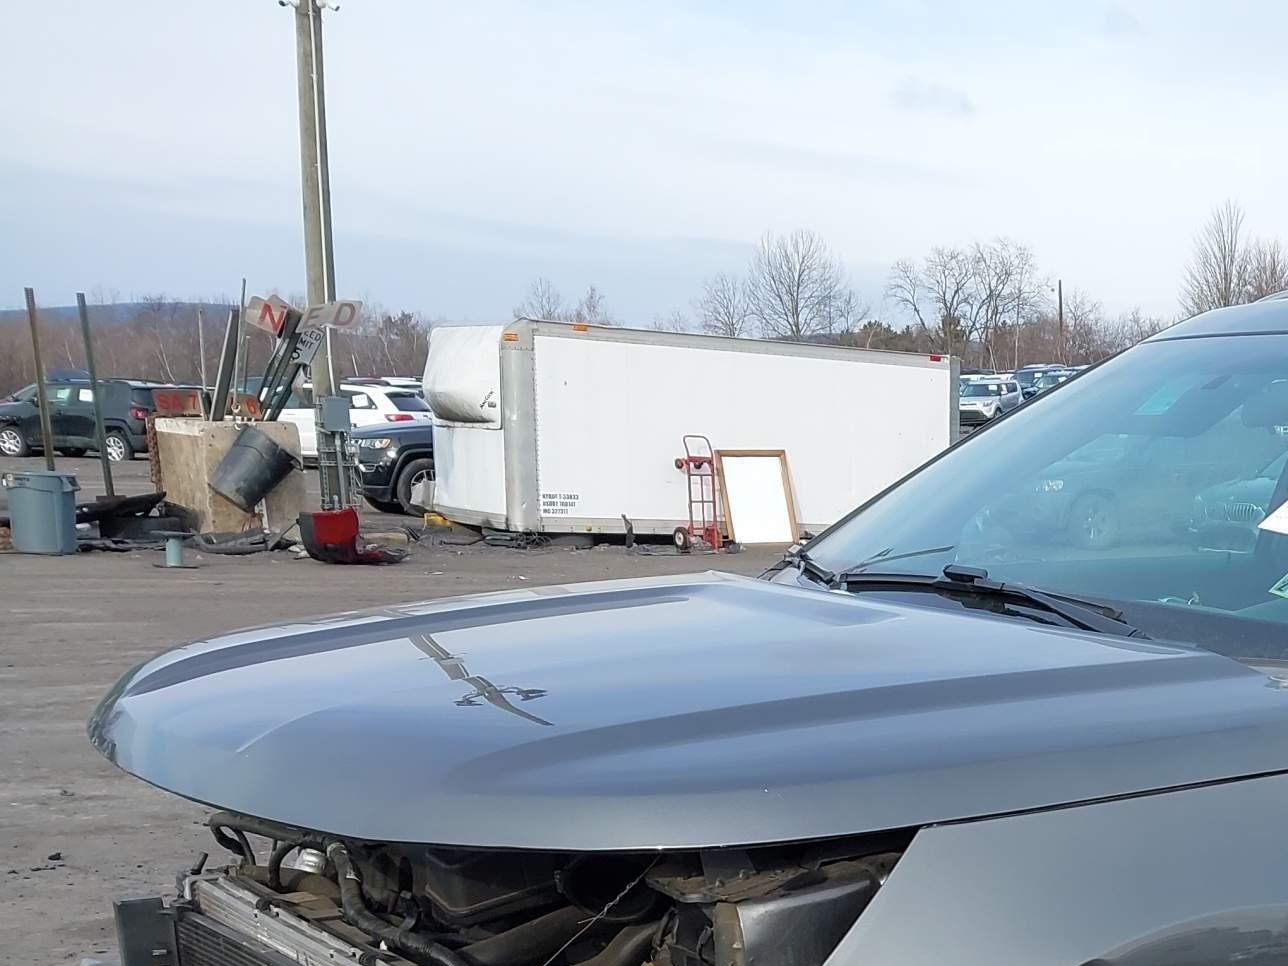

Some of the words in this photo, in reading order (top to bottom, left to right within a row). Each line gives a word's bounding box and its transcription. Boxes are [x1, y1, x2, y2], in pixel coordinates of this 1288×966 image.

[259, 303, 288, 332] N
[334, 302, 356, 327] D
[299, 337, 314, 349] MIT
[303, 330, 322, 341] EED
